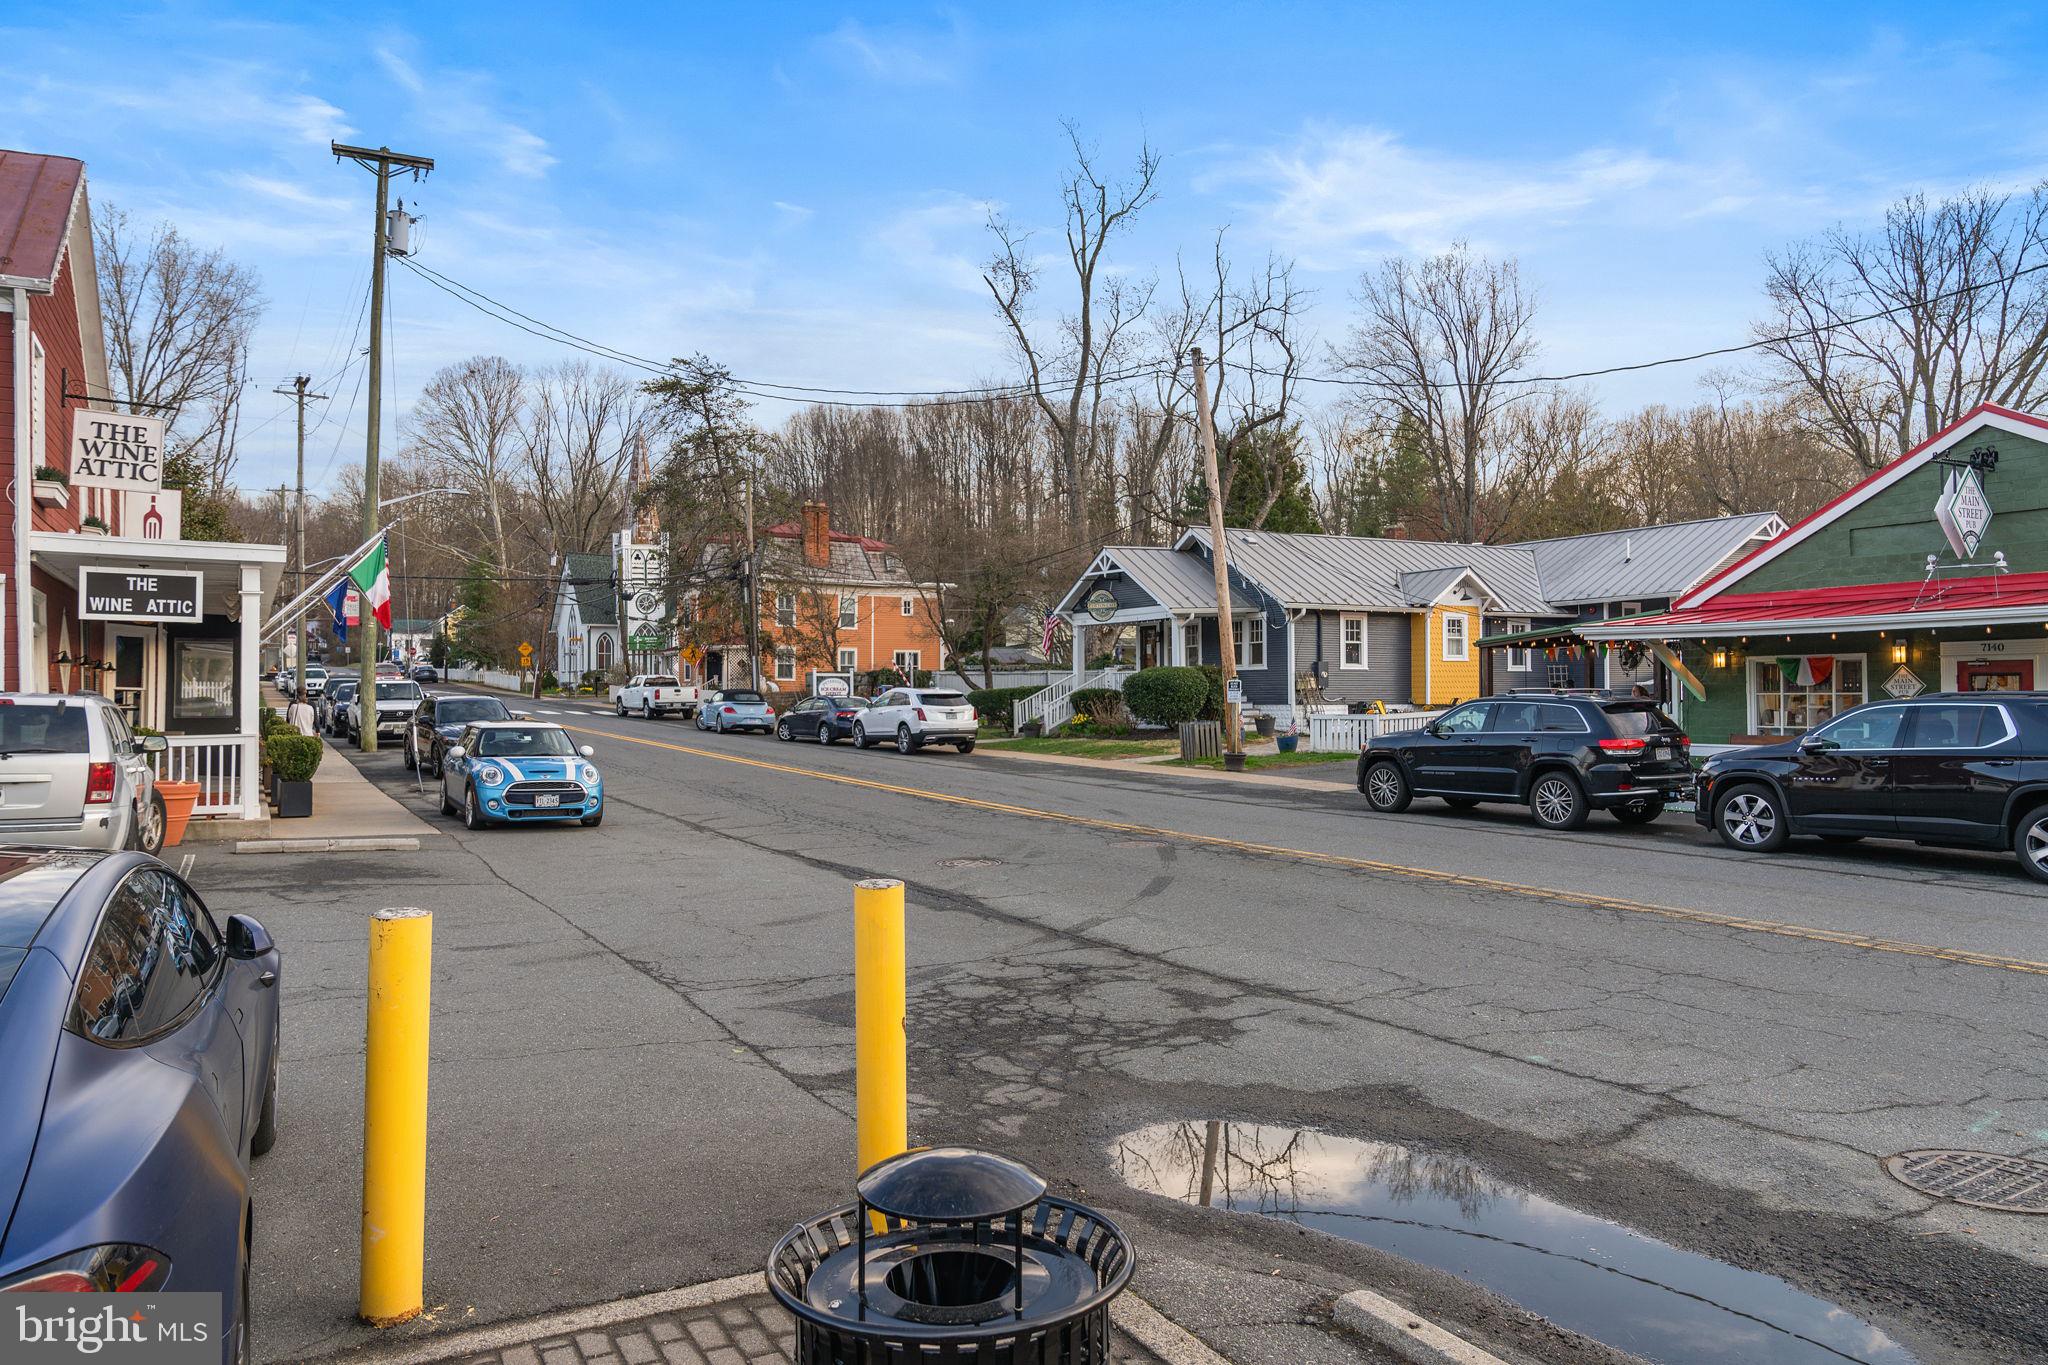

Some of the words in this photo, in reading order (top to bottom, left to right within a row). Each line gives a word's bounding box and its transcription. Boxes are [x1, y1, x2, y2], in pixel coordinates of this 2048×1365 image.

[91, 421, 147, 444] THE
[79, 438, 157, 463] WINE
[74, 457, 157, 482] ATTIC
[1965, 486, 1976, 495] THE
[1961, 495, 1980, 506] MAIN
[1958, 507, 1984, 520] STREET
[1965, 520, 1977, 529] PUB
[126, 576, 158, 592] THE
[89, 596, 133, 612] WINE
[146, 598, 193, 614] ATTIC
[1980, 642, 2005, 652] 7140
